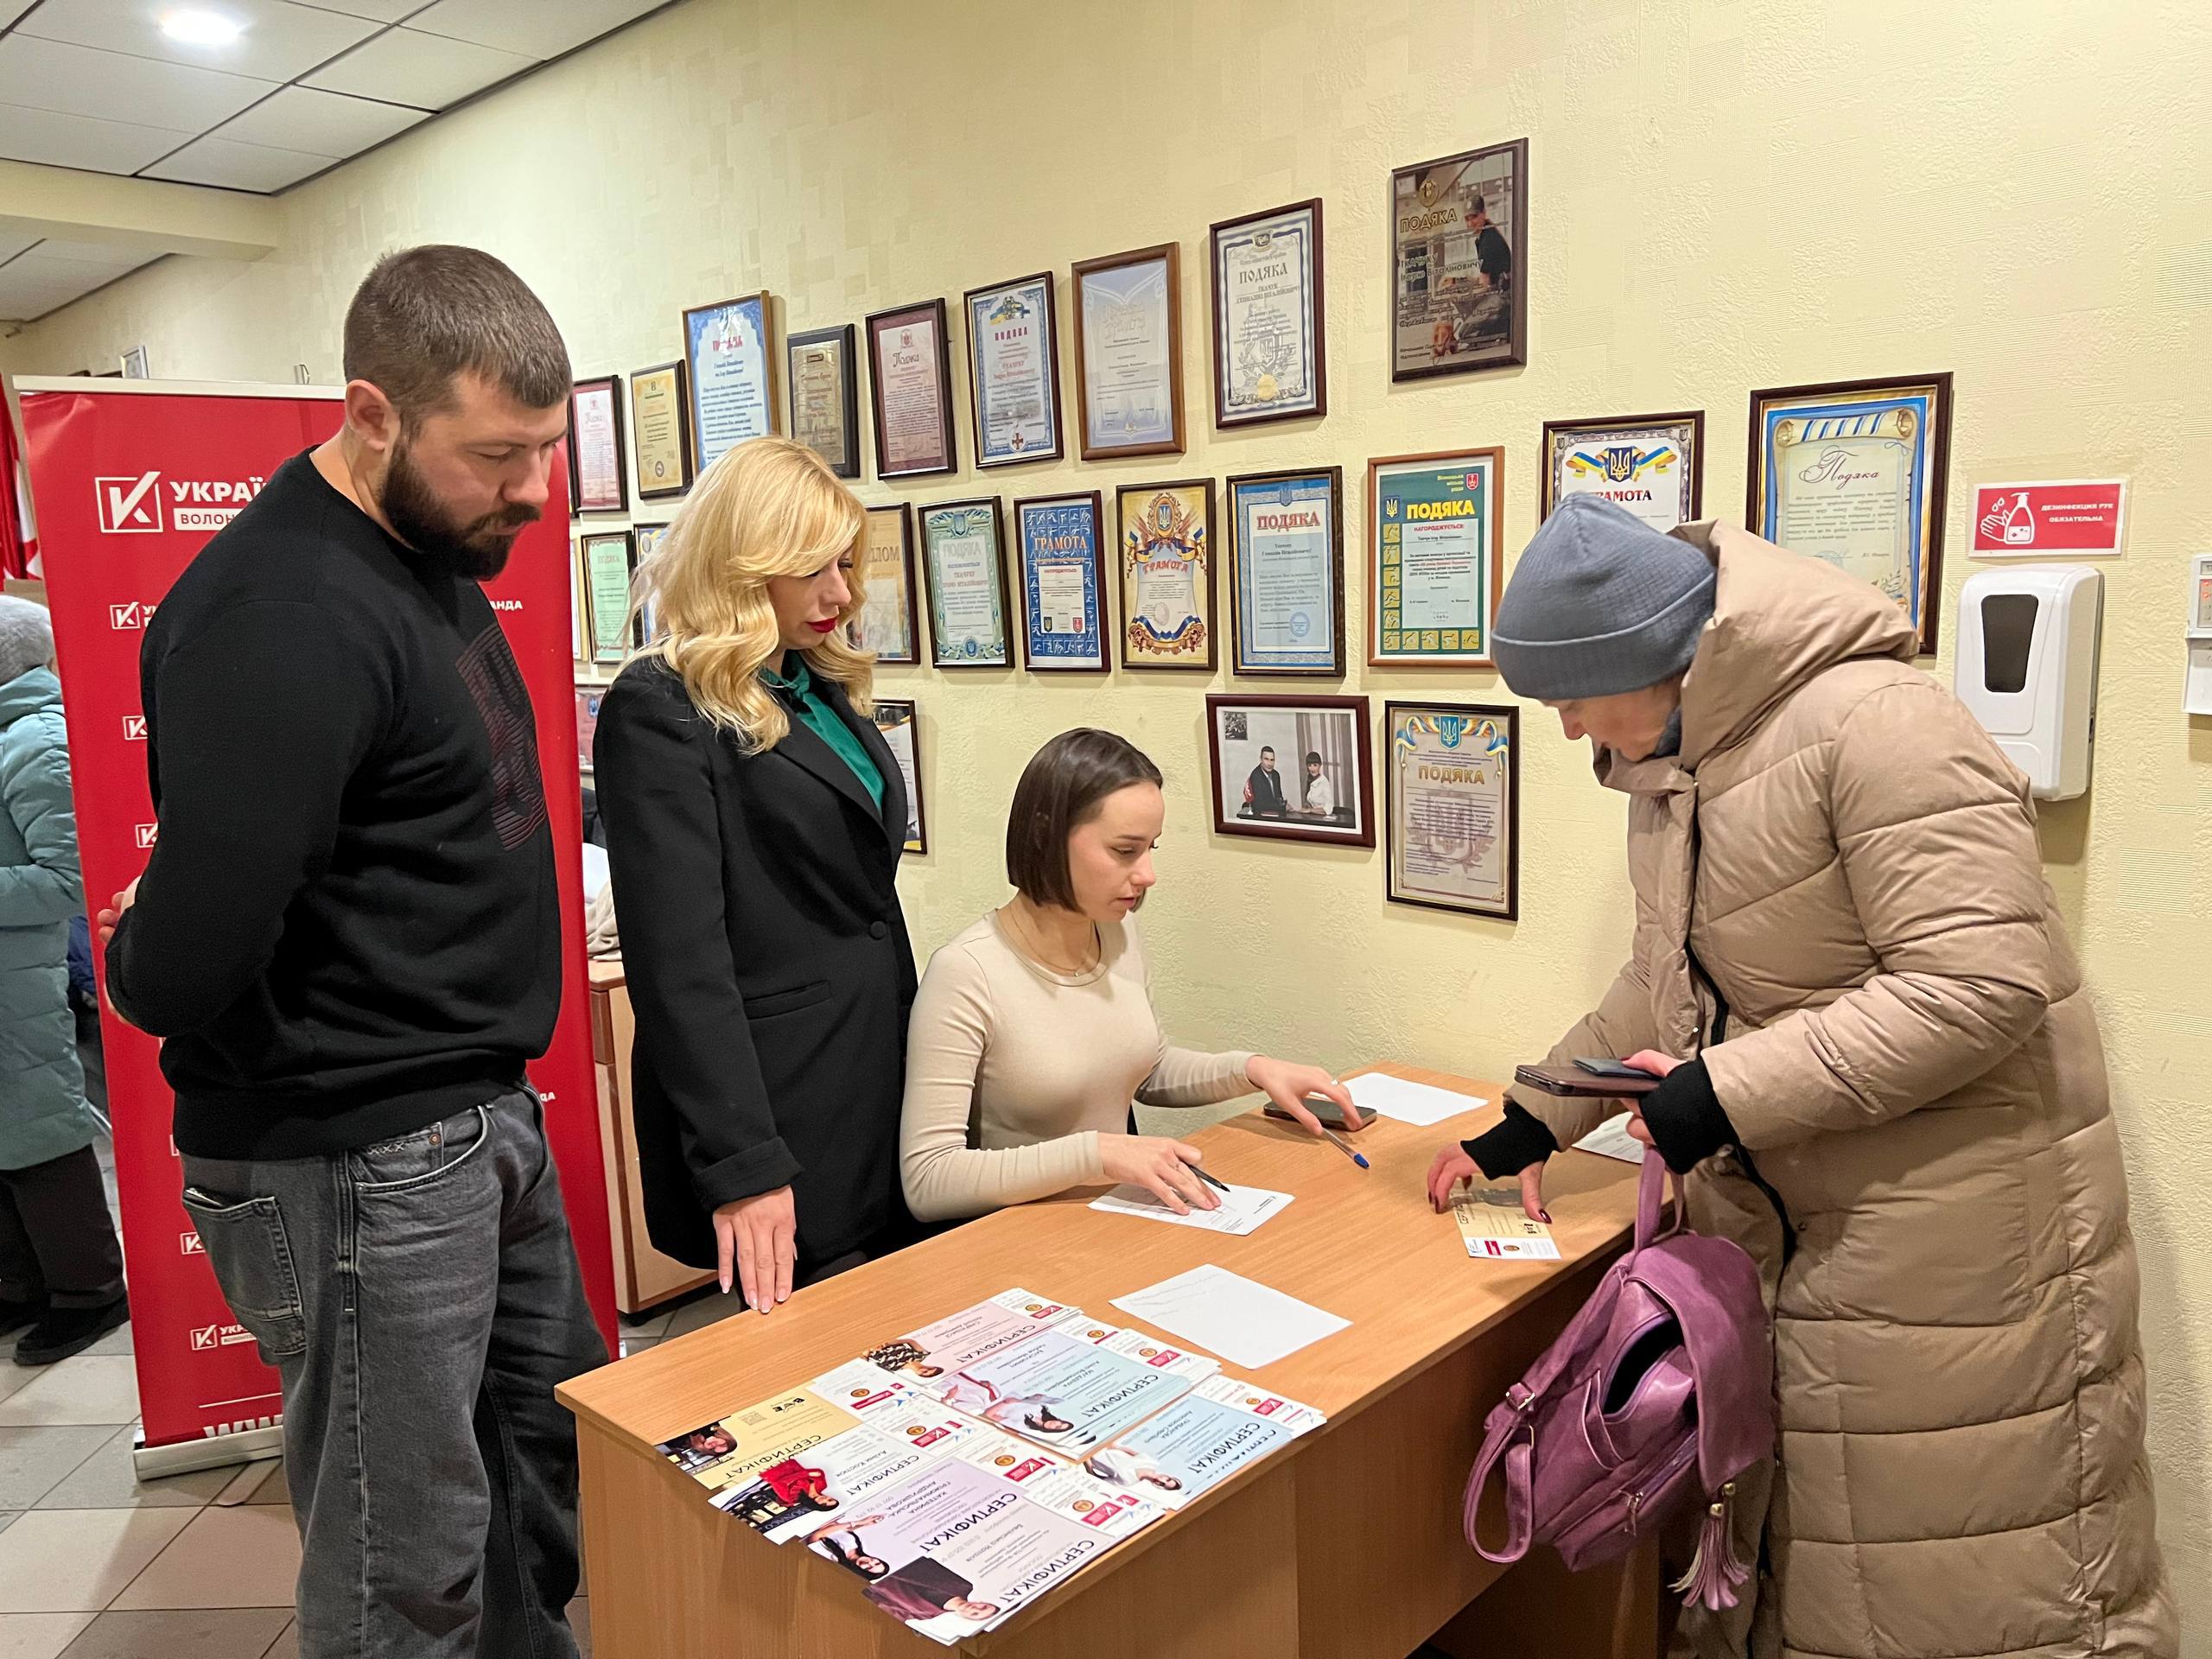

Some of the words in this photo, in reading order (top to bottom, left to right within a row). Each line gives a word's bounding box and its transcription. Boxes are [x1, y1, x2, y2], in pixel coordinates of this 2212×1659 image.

[1399, 207, 1458, 233] ПОДЯКА
[1239, 262, 1287, 283] ПОДЯКА
[995, 327, 1028, 340] ПОДЯКА
[1799, 445, 1879, 490] Подяка
[1257, 512, 1320, 532] ПОДЯКА
[1407, 499, 1475, 520] ПОДЯКА
[944, 542, 982, 559] ПОДЯКА
[1034, 537, 1087, 550] ГРАМОТА
[1142, 559, 1188, 574] ГРАМОТА
[1418, 766, 1484, 785] ПОДЯКА
[955, 1324, 1038, 1362] СЕРТИФІКАТ
[1079, 1374, 1162, 1417] СЕРТИФІКАТ
[724, 1433, 822, 1478] СЕРТИФІКАТ
[1185, 1421, 1262, 1473] СЕРТИФІКАТ
[845, 1454, 919, 1495] СЕРТИФІКАТ
[917, 1491, 1020, 1552] СЕРТИФІКАТ
[998, 1538, 1096, 1604] СЕРТИФІКАТ
